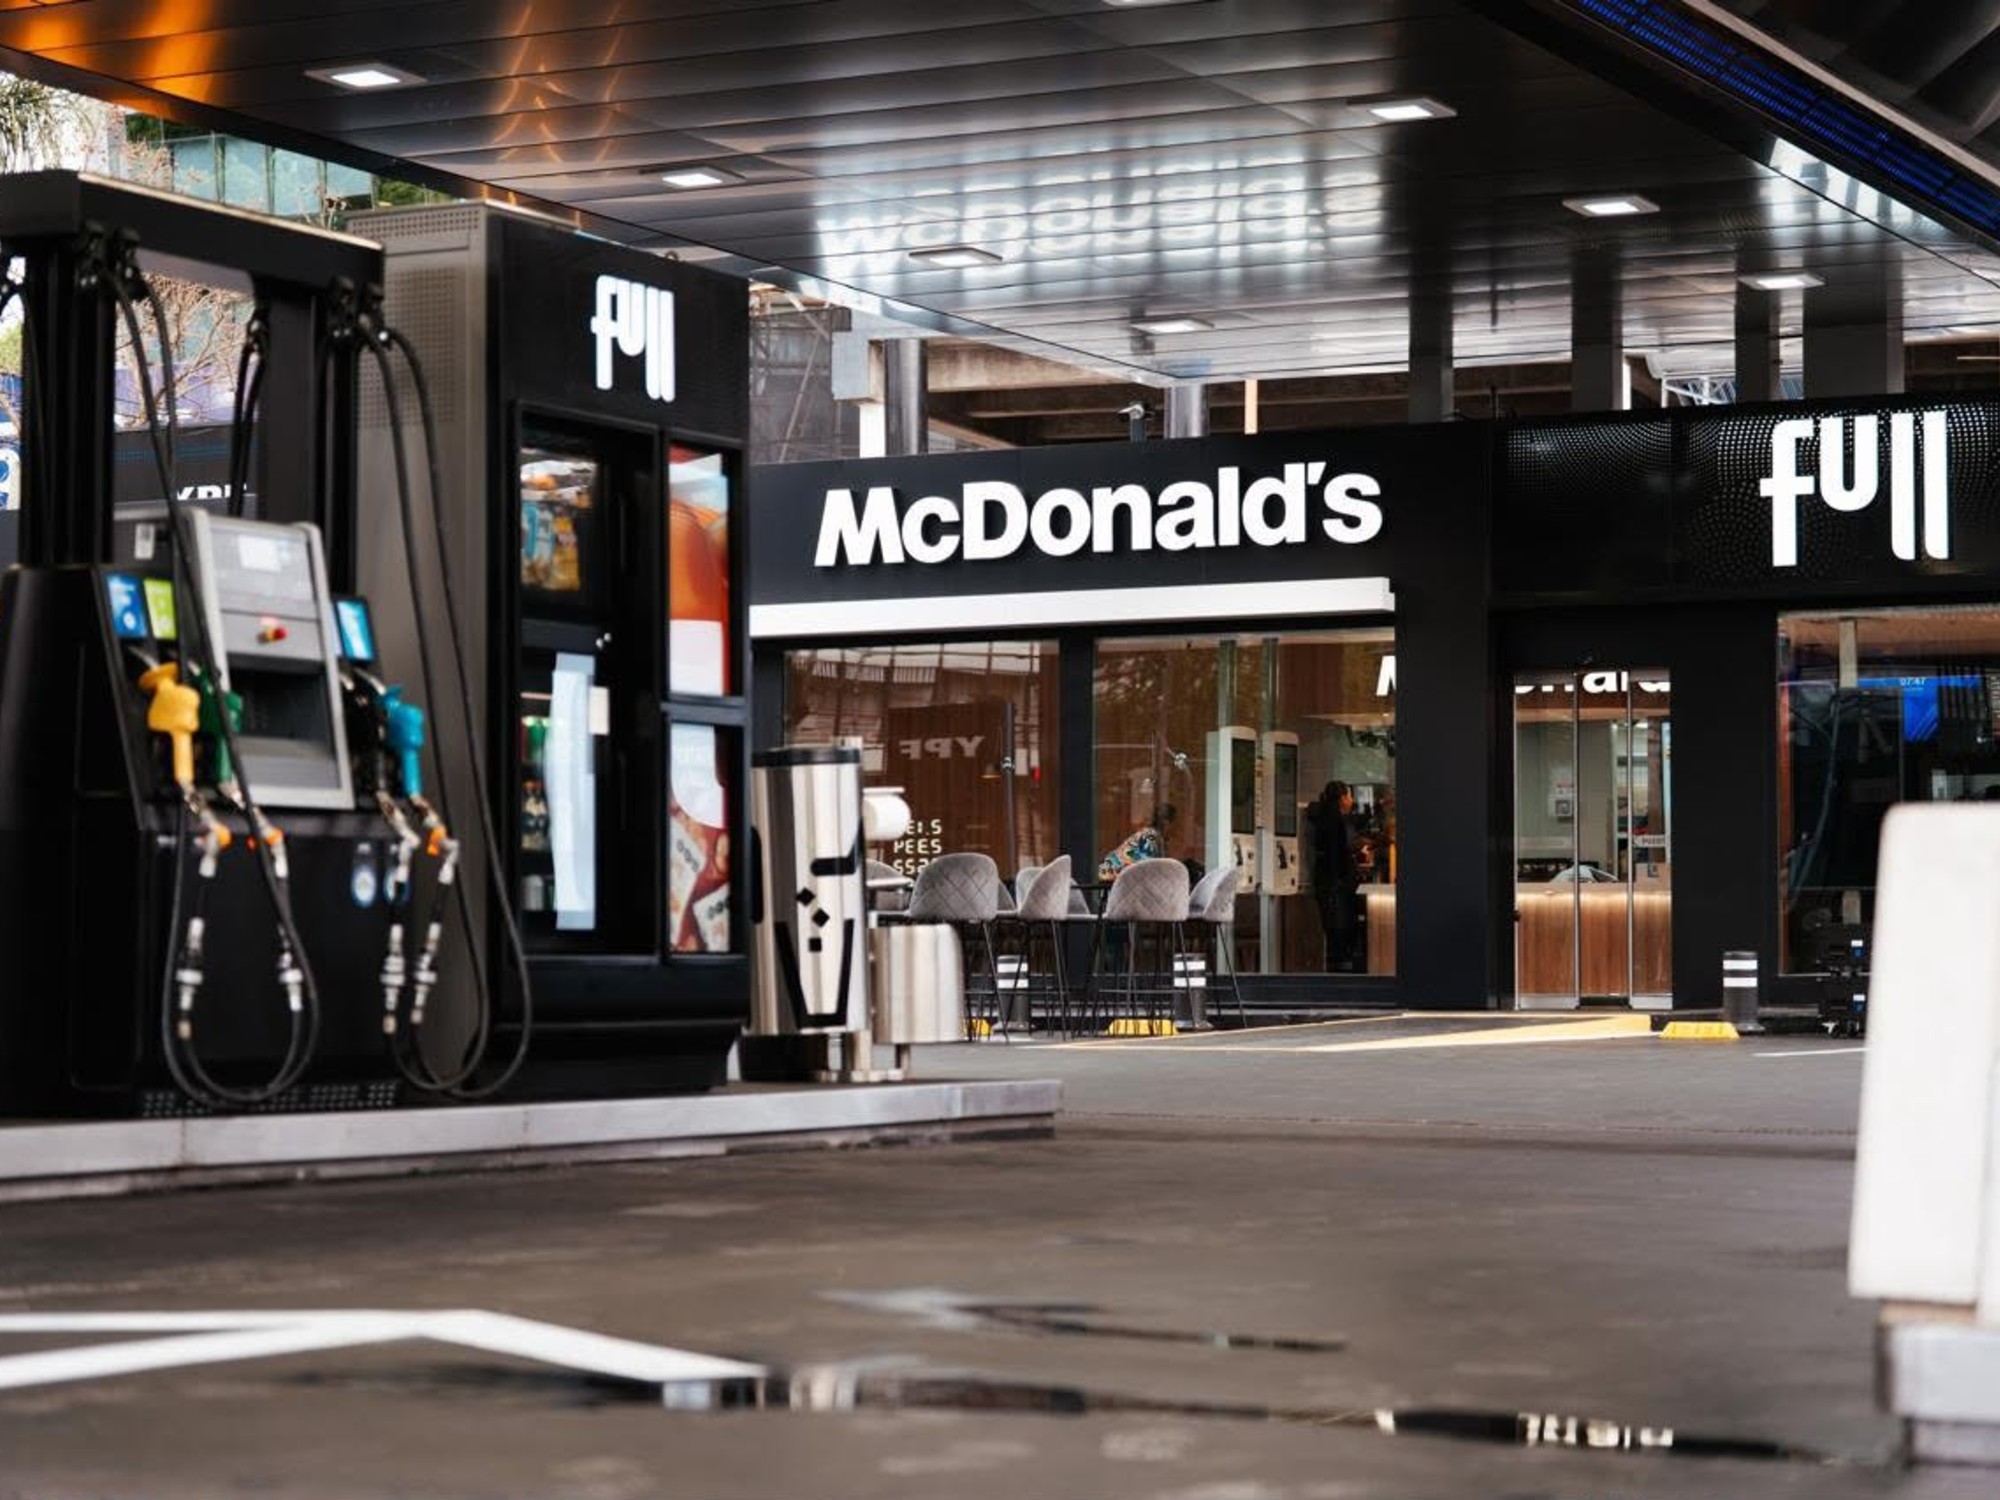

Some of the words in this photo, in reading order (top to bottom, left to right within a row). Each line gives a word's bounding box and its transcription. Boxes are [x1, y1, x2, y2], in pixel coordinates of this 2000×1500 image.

[590, 275, 675, 402] full
[814, 462, 1383, 567] McDonald's
[1759, 410, 1949, 567] full
